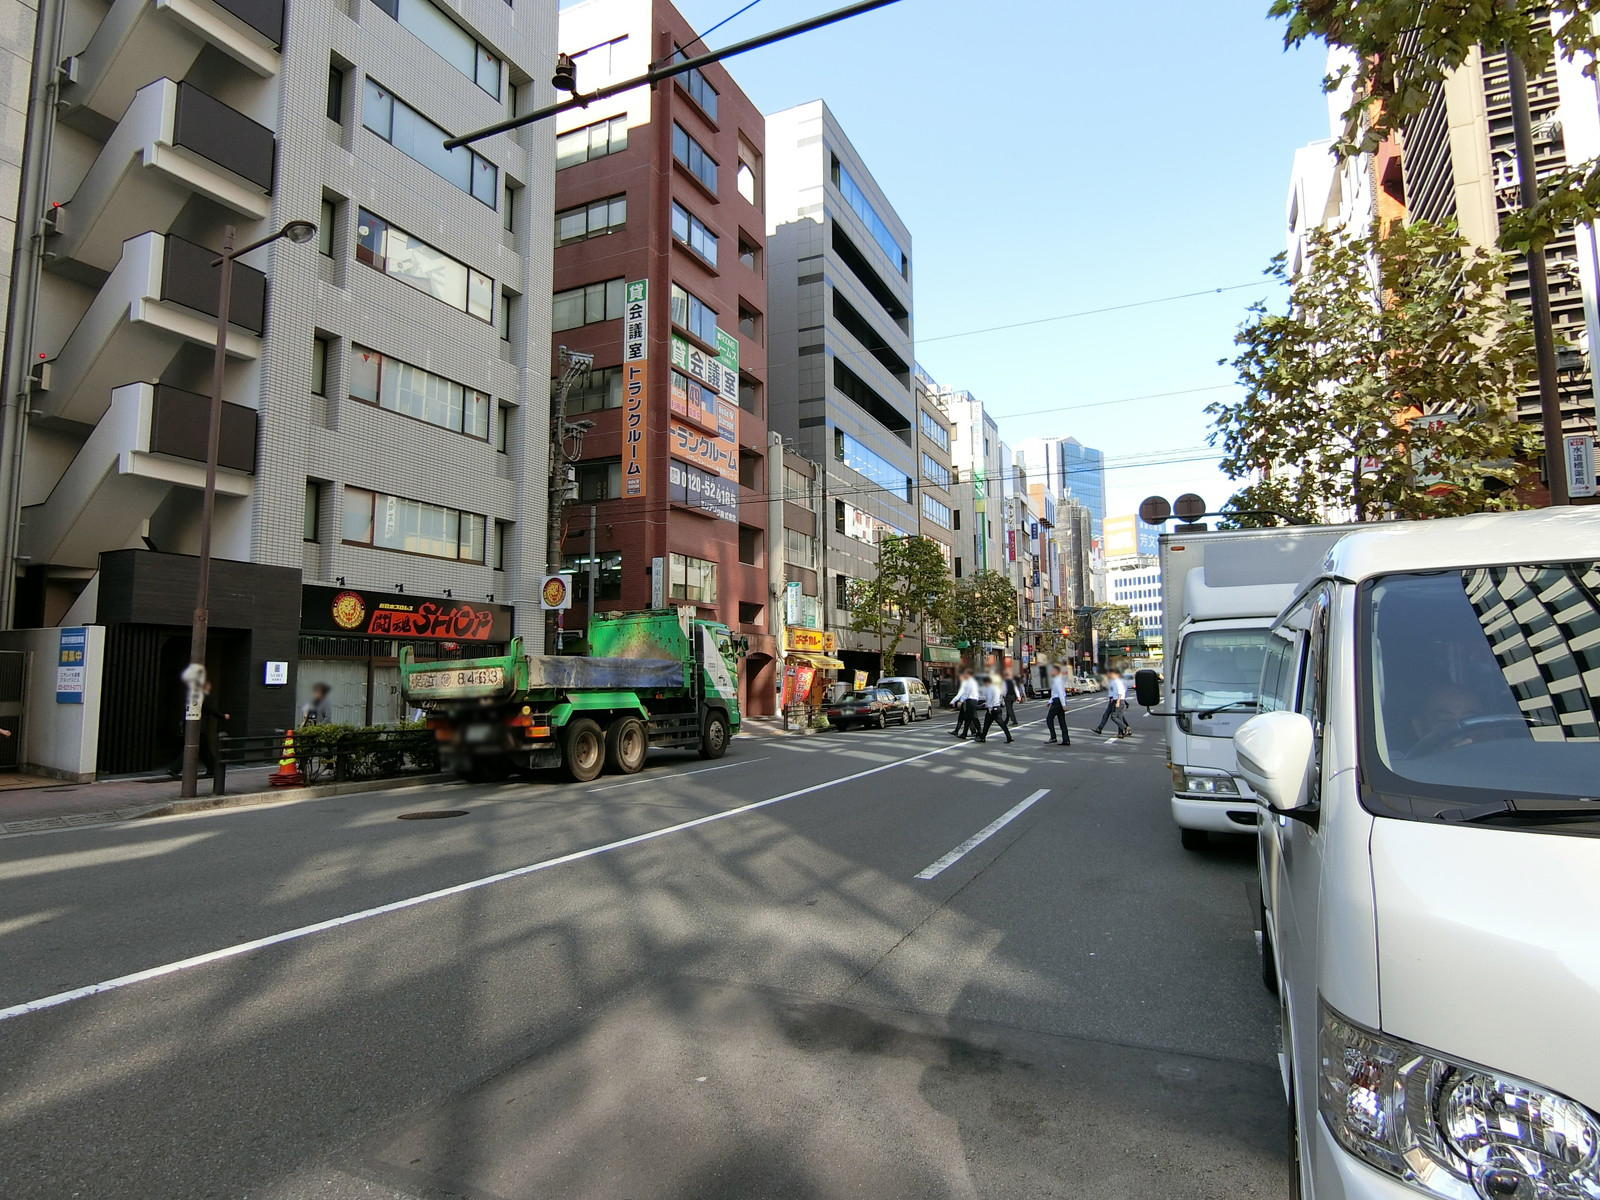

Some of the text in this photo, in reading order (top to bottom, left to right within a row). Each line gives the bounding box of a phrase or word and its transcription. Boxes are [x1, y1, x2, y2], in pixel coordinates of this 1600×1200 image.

[628, 283, 644, 360] 貸会議室
[672, 338, 737, 398] 貸会議室
[626, 366, 642, 476] トランクルーム
[1140, 533, 1159, 548] 芳文
[412, 601, 493, 638] SHOP
